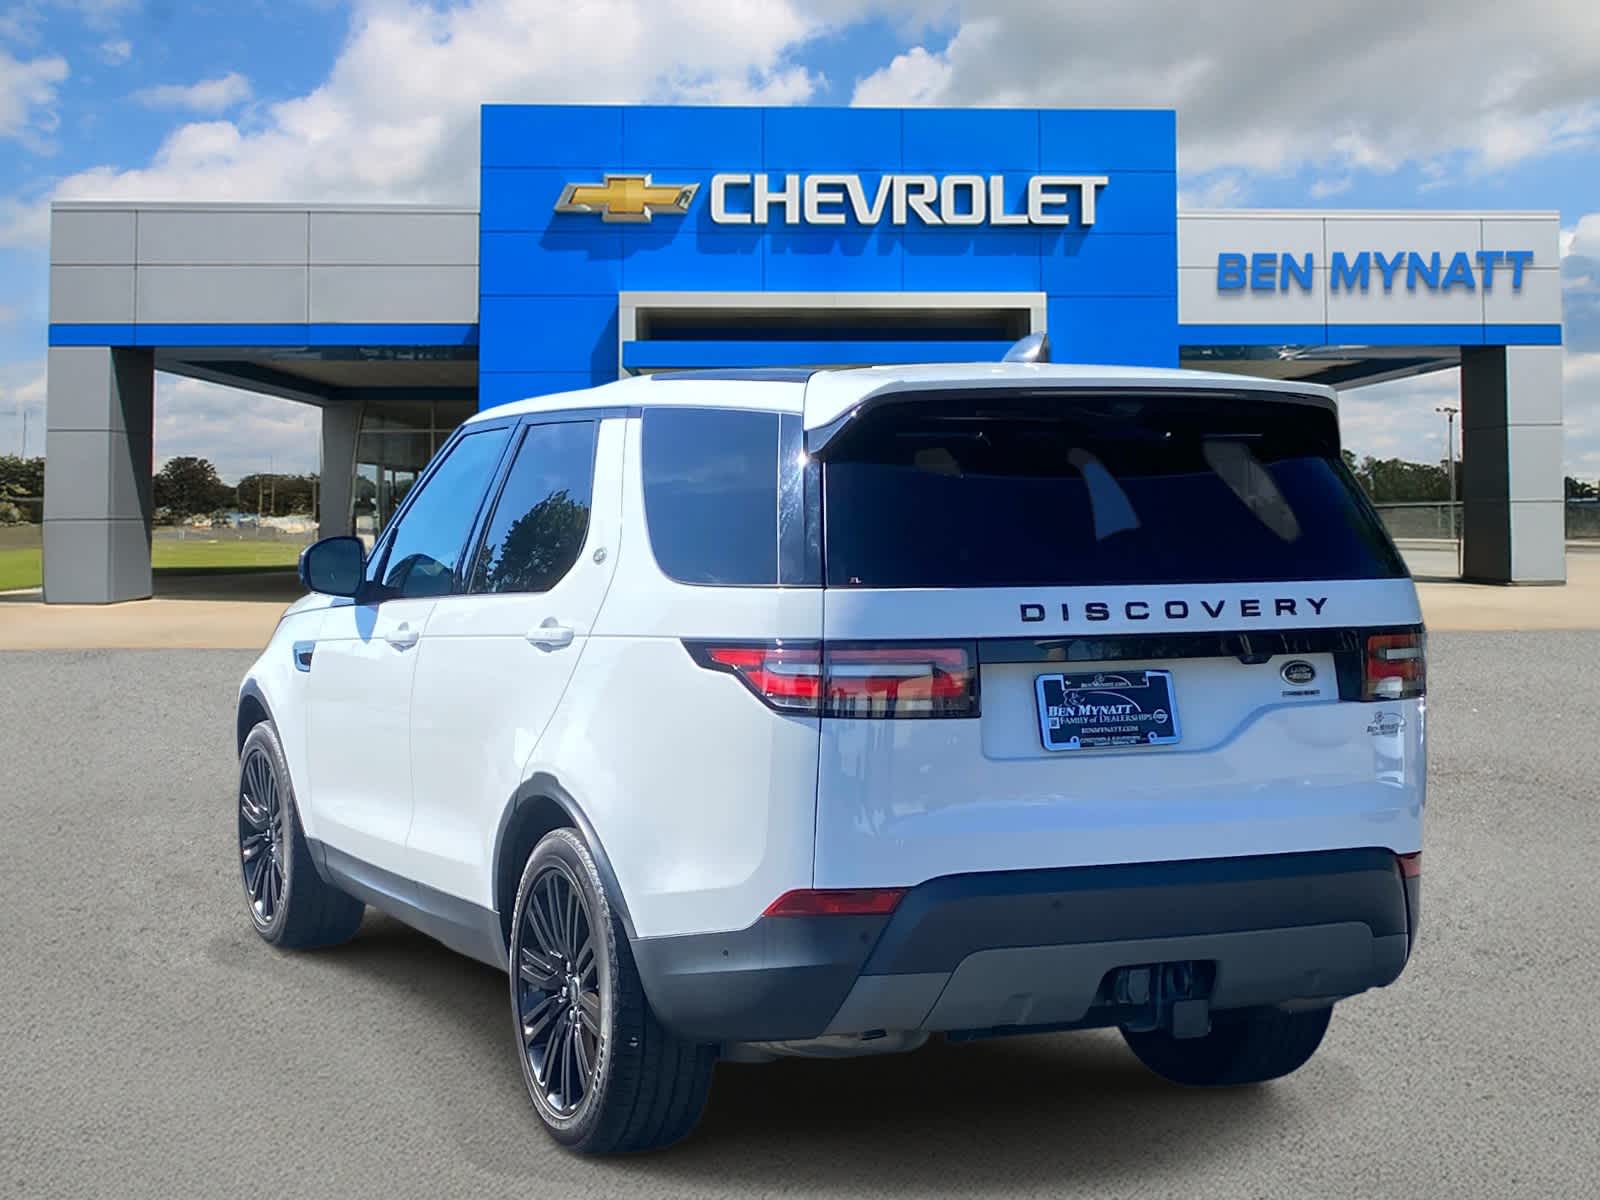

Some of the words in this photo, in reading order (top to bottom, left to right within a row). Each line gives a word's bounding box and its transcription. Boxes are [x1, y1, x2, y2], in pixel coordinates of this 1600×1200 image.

[710, 173, 1109, 225] CHEVROLET
[1217, 252, 1313, 290] BEN
[1330, 250, 1534, 290] MYNATT
[1020, 597, 1328, 622] DISCOVERY
[1079, 704, 1133, 716] MYNATT
